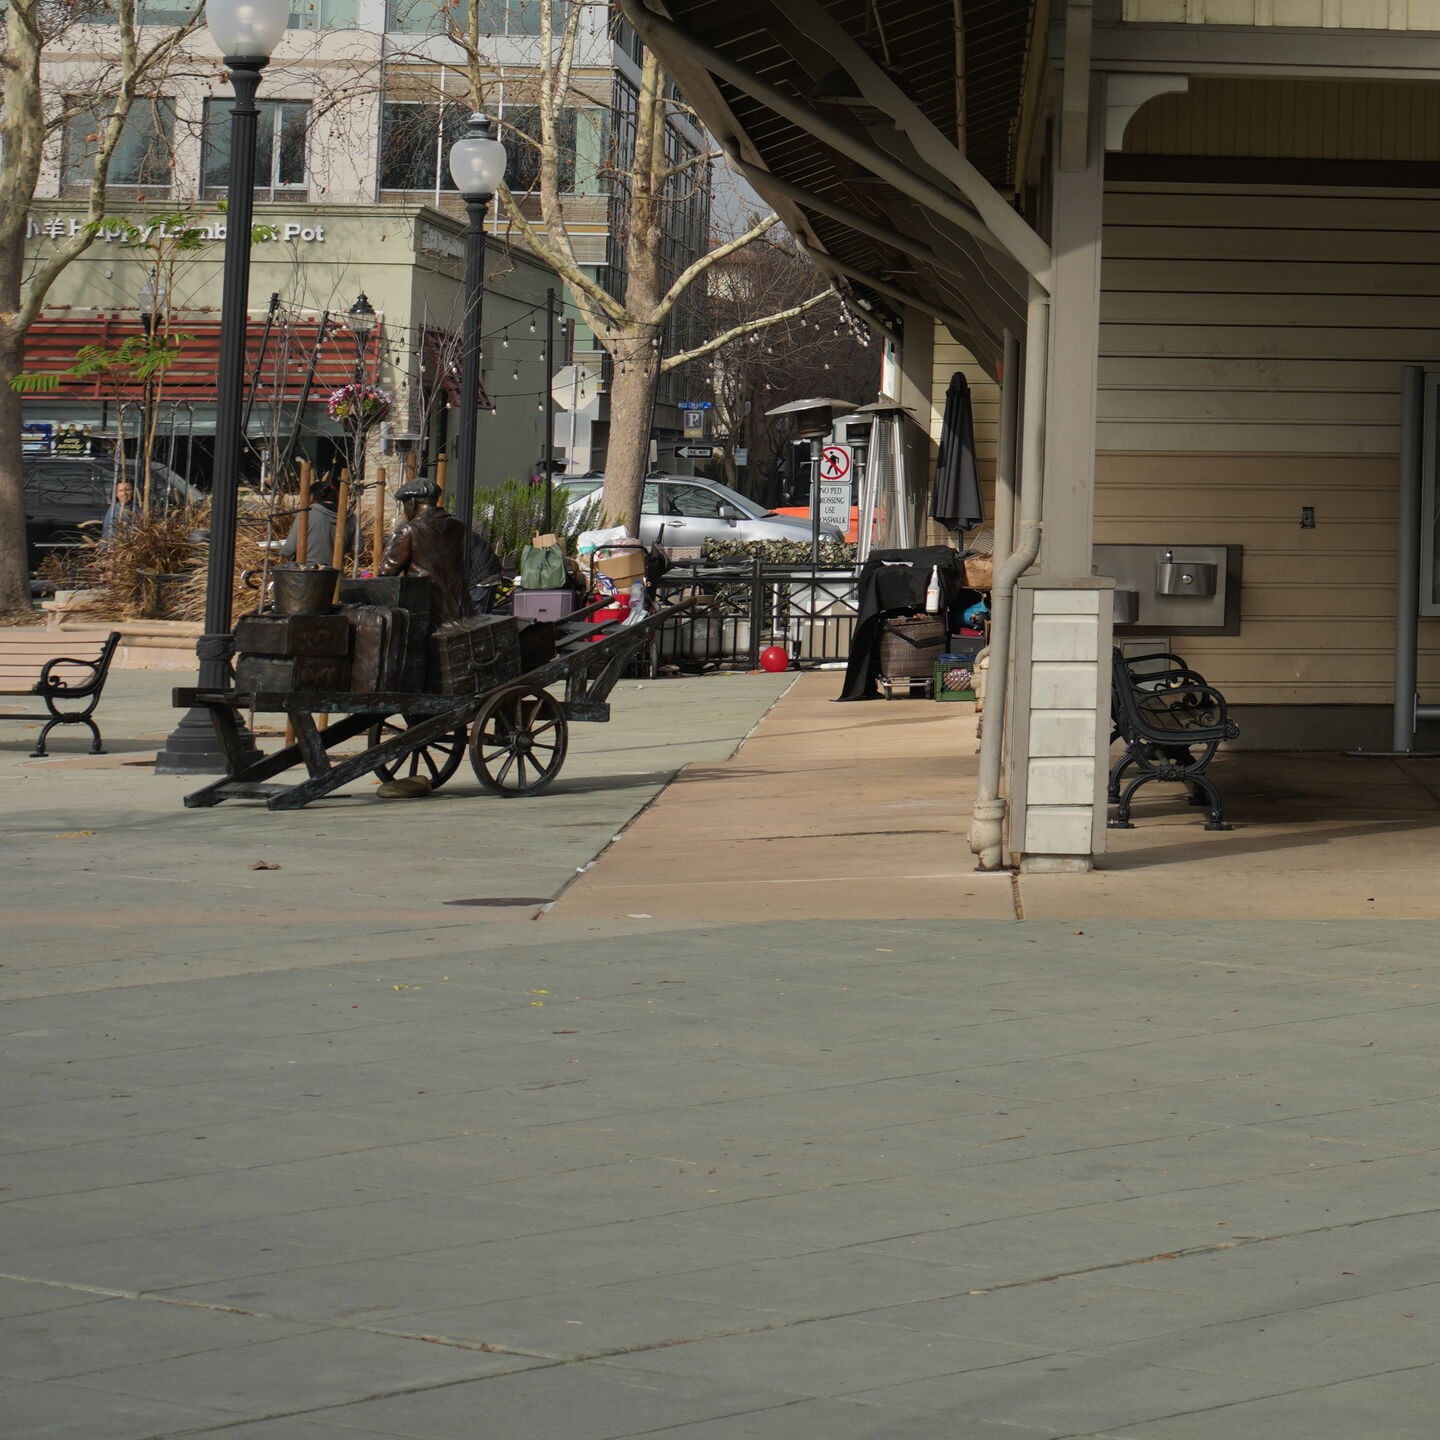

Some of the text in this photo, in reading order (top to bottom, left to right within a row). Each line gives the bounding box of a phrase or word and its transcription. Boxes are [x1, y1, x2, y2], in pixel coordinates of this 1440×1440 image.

[284, 222, 324, 242] Pot
[687, 412, 700, 428] P
[820, 486, 843, 495] NO PED
[824, 506, 835, 514] USE
